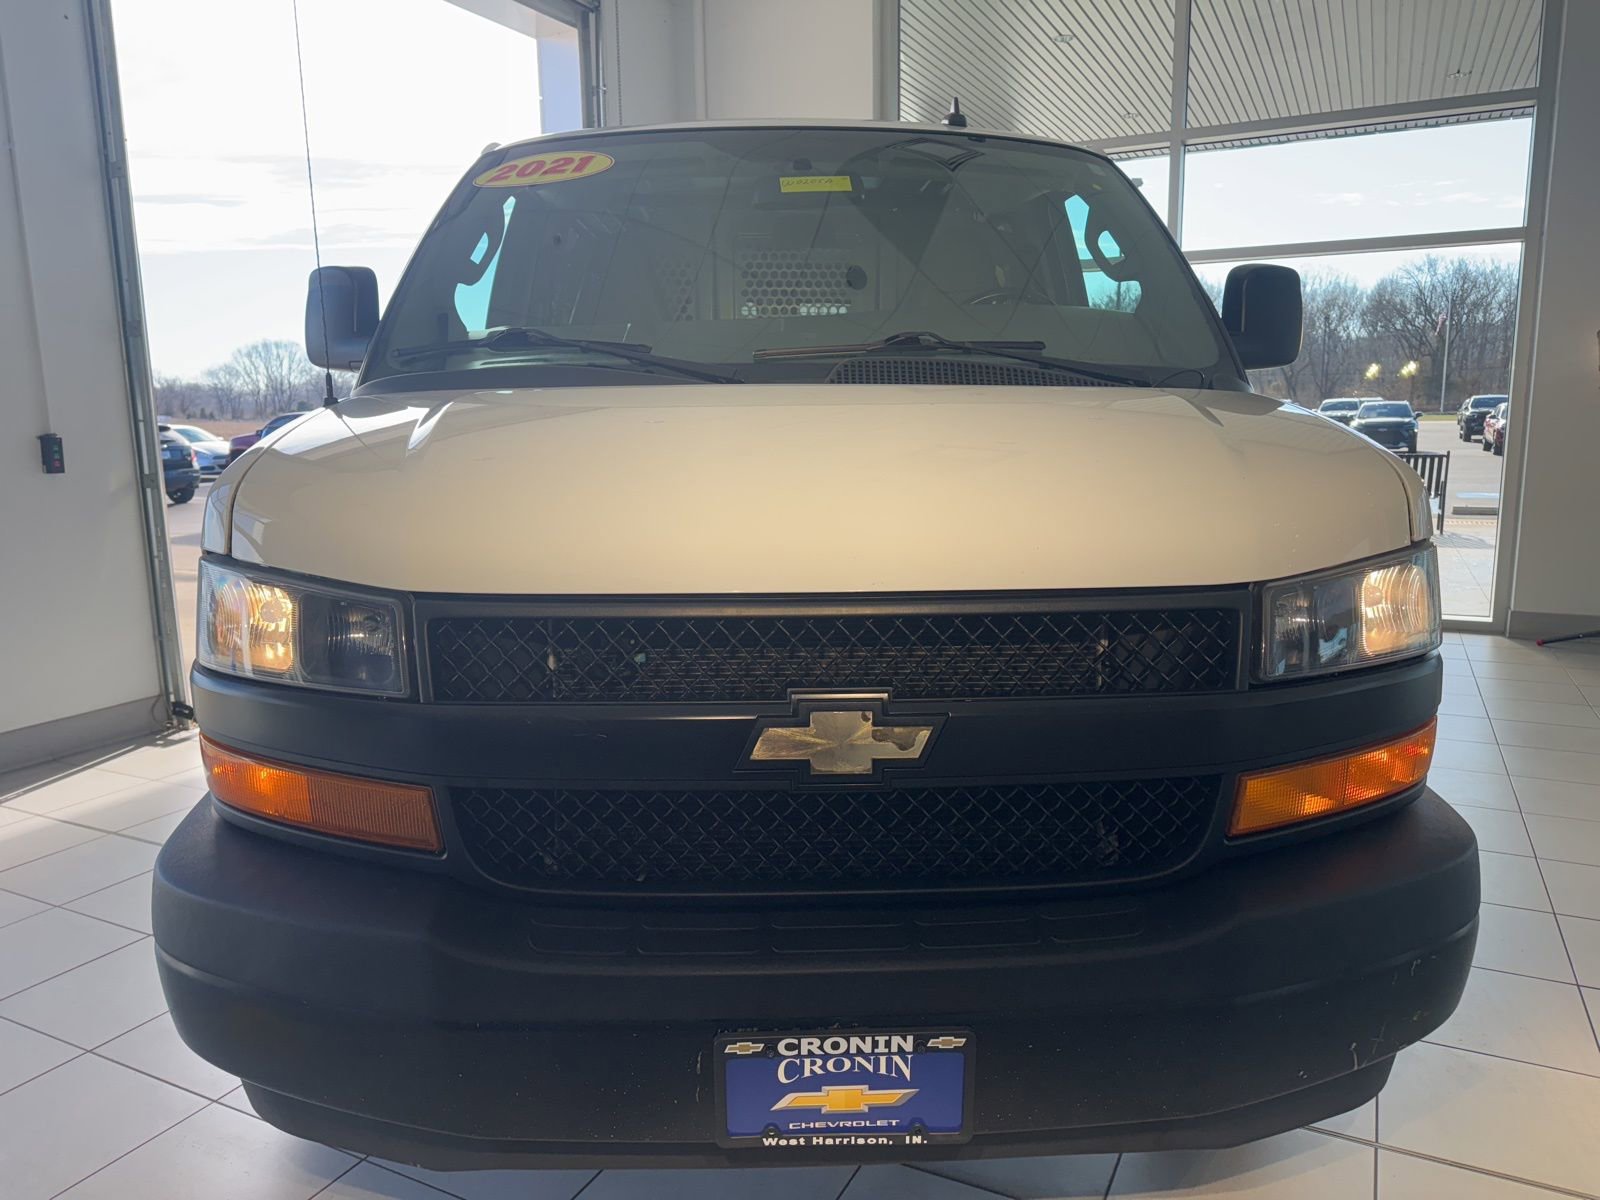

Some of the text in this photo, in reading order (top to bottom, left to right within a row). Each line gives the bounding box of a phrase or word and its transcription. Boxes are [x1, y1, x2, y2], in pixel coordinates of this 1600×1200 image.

[484, 155, 596, 184] 2021
[777, 1035, 914, 1056] CRONIN
[777, 1055, 914, 1084] CRONIN
[789, 1119, 900, 1130] CHEVROLET
[762, 1135, 928, 1146] West Harrison, IN.
